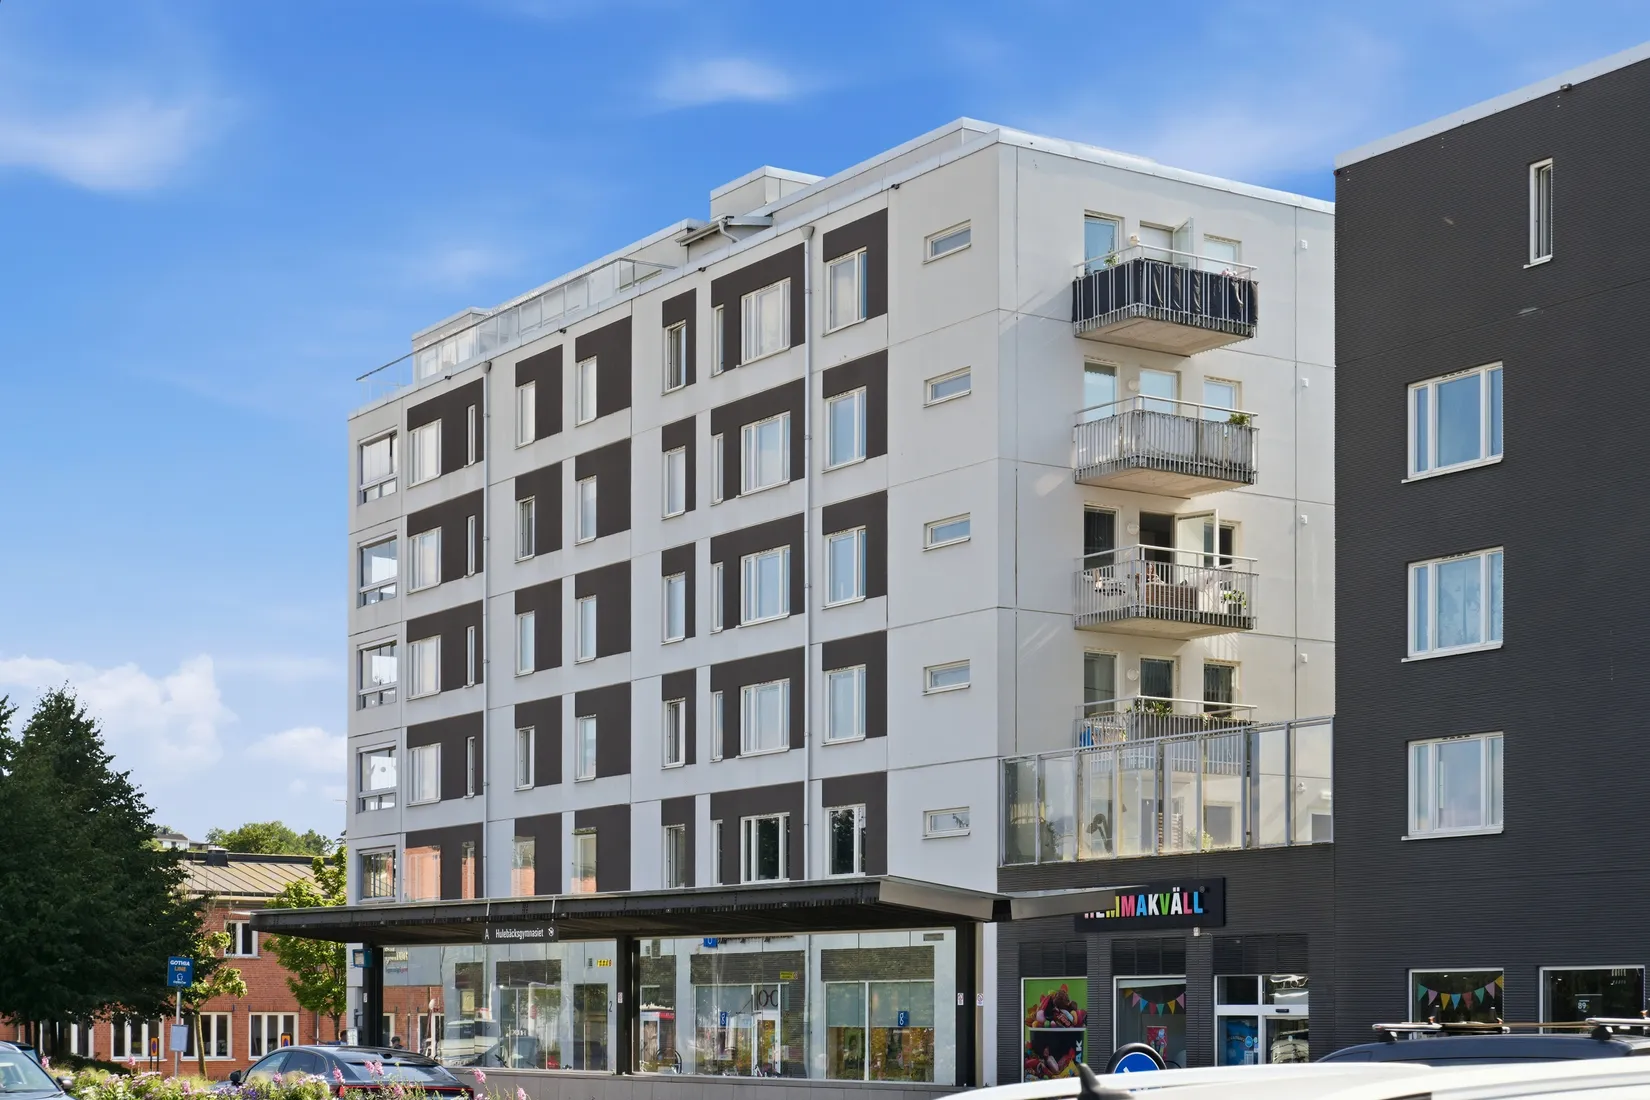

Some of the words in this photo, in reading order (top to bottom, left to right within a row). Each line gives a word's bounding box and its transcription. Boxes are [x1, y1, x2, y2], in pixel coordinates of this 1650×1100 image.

[1084, 887, 1203, 918] MMAKVÄLL
[485, 928, 490, 940] A
[495, 928, 544, 940] Hulebäcksgymnasiet
